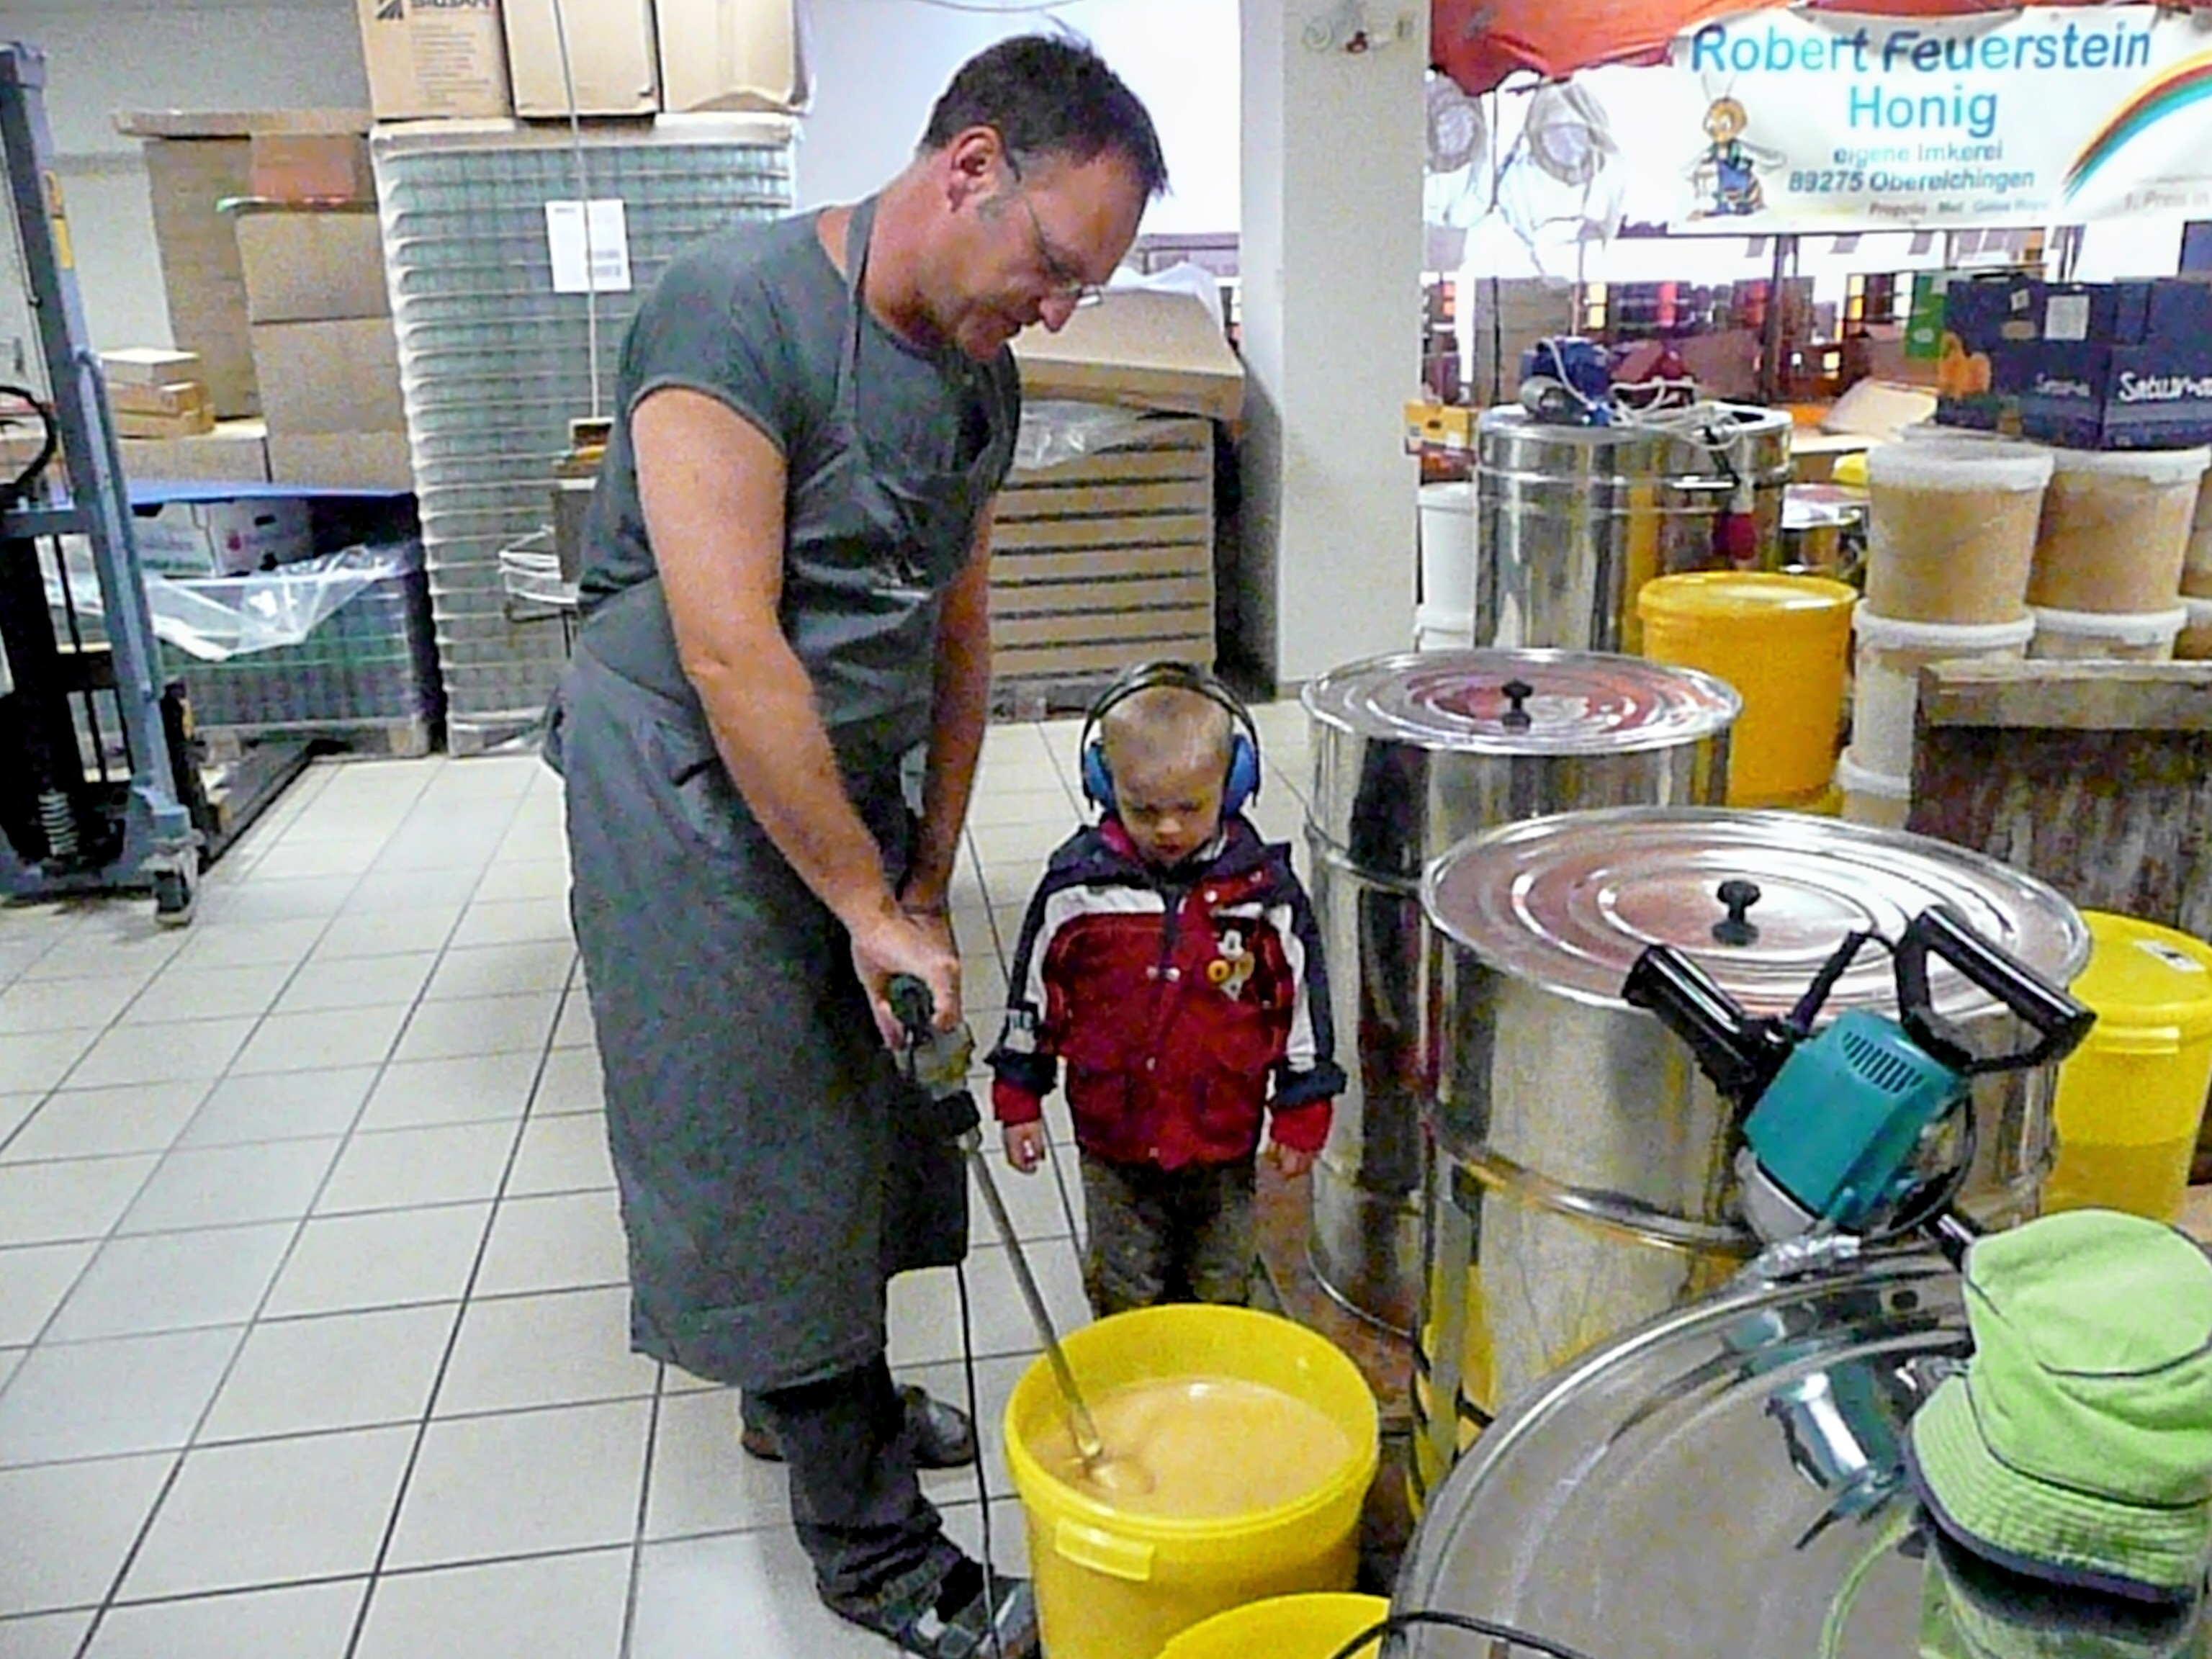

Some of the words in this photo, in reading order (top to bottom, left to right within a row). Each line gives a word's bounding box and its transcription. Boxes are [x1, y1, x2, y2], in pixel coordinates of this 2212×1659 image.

[1691, 24, 1869, 72] Robert
[1883, 22, 2152, 72] Feuerstein
[1848, 84, 1998, 138] Honig
[1833, 145, 1909, 168] eigene
[1917, 140, 2002, 162] Imkerei
[1788, 171, 1863, 192] 89275
